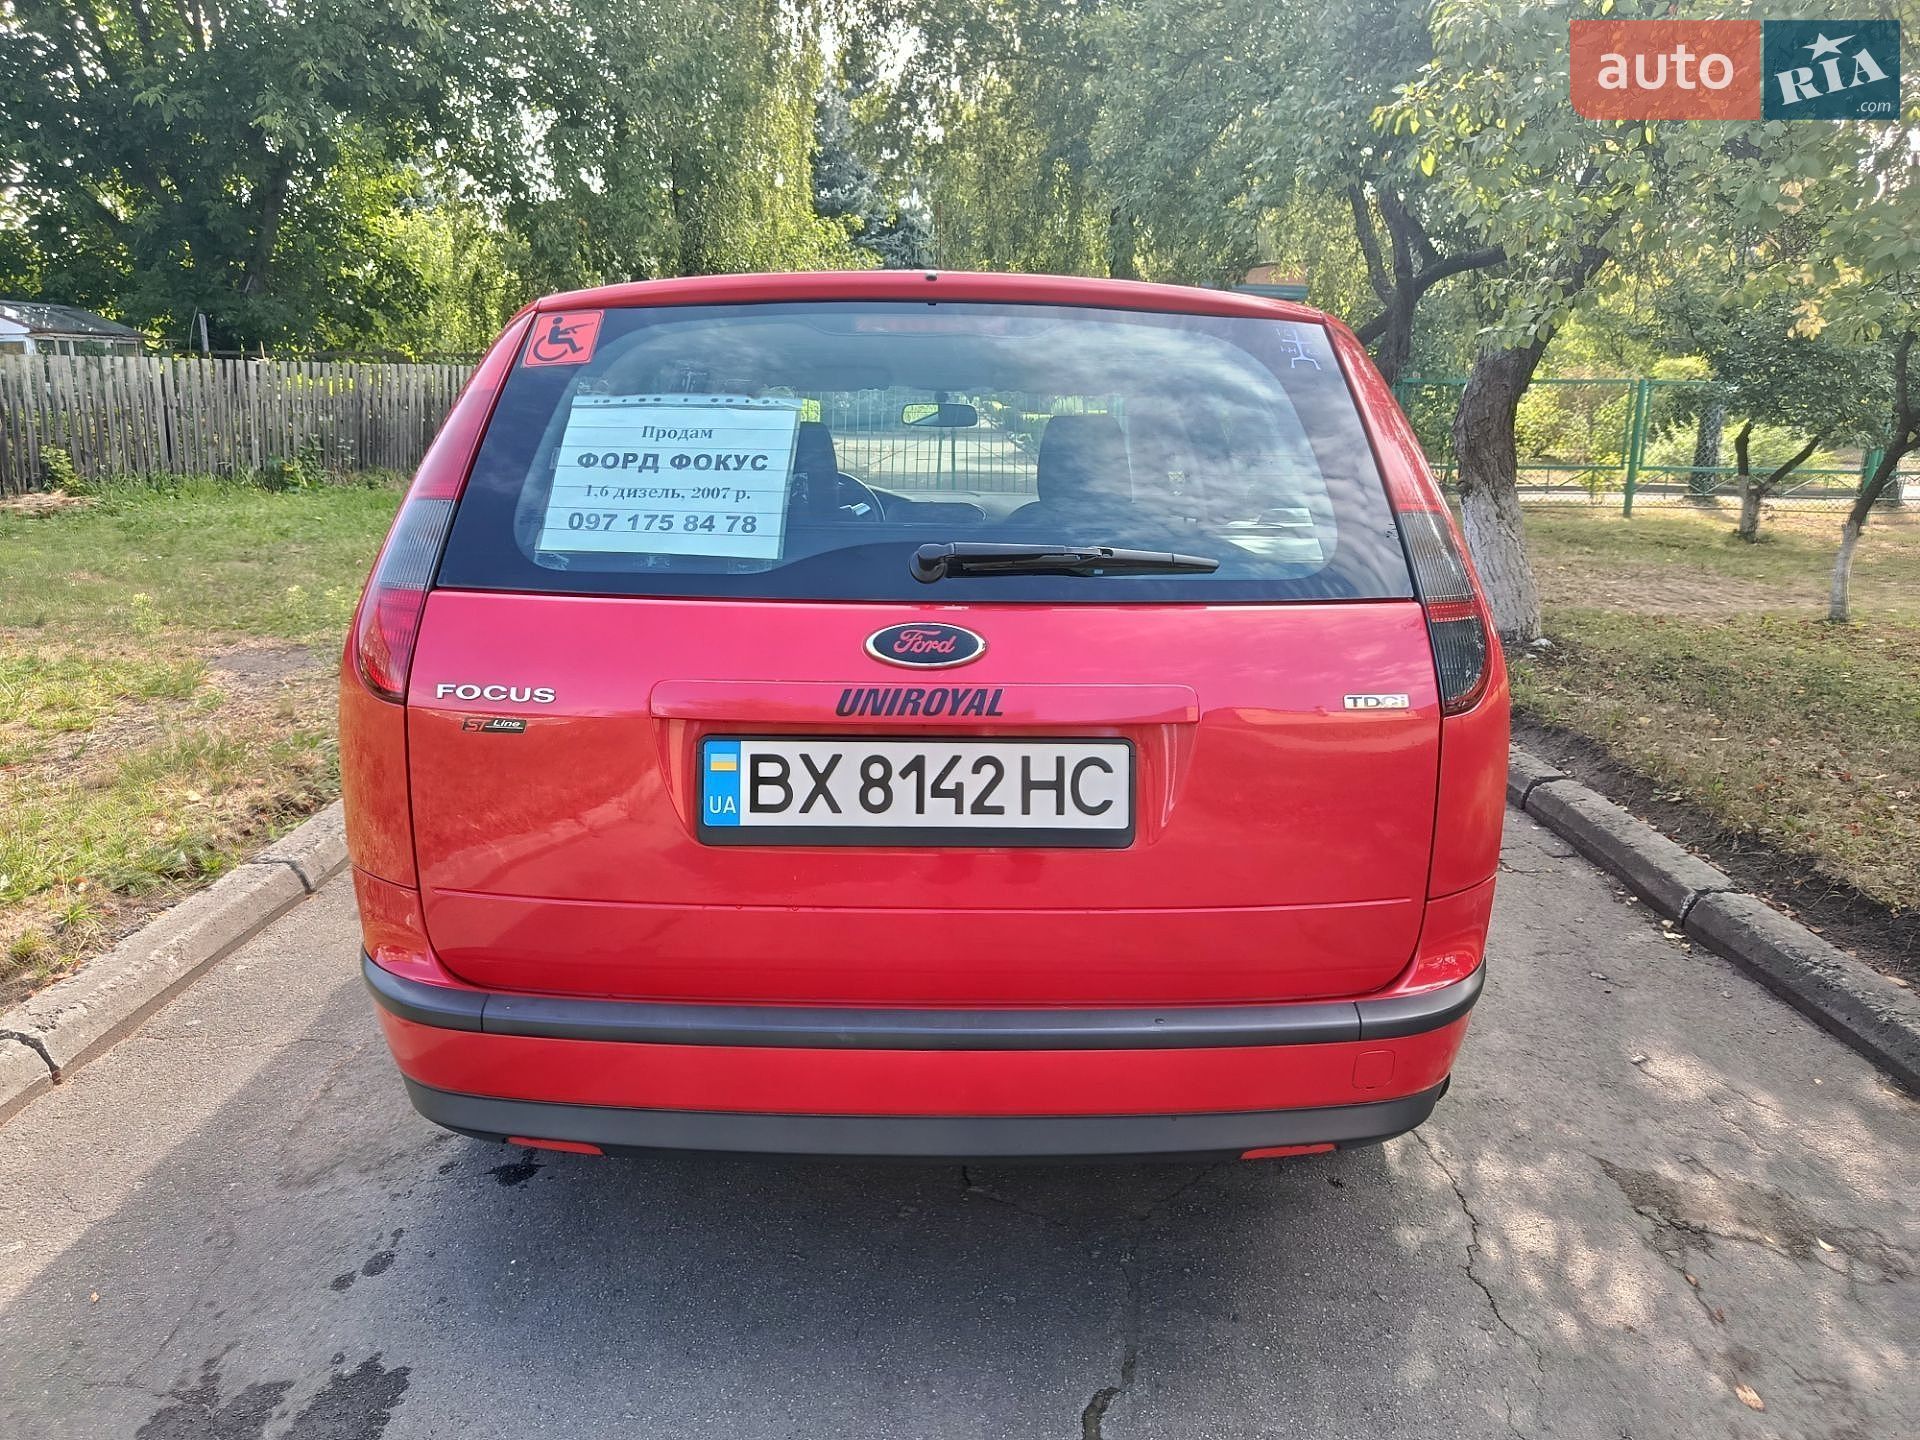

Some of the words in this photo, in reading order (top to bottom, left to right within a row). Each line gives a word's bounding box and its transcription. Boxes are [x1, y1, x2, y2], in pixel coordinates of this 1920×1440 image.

[641, 425, 713, 442] Продам
[577, 452, 660, 473] ФОРД
[670, 452, 769, 471] ФОКУС
[691, 486, 731, 500] 2007
[735, 488, 751, 502] р.
[568, 512, 618, 531] 097
[627, 513, 674, 532] 175
[683, 514, 715, 533] 84
[726, 515, 757, 534] 78
[893, 629, 957, 655] Ford
[436, 683, 556, 703] FOCUS
[835, 687, 1005, 717] UNIROYAL
[1345, 695, 1407, 708] TDCi
[465, 719, 491, 732] ST
[493, 719, 521, 728] Line
[859, 754, 1005, 815] 8142
[709, 795, 737, 814] UA
